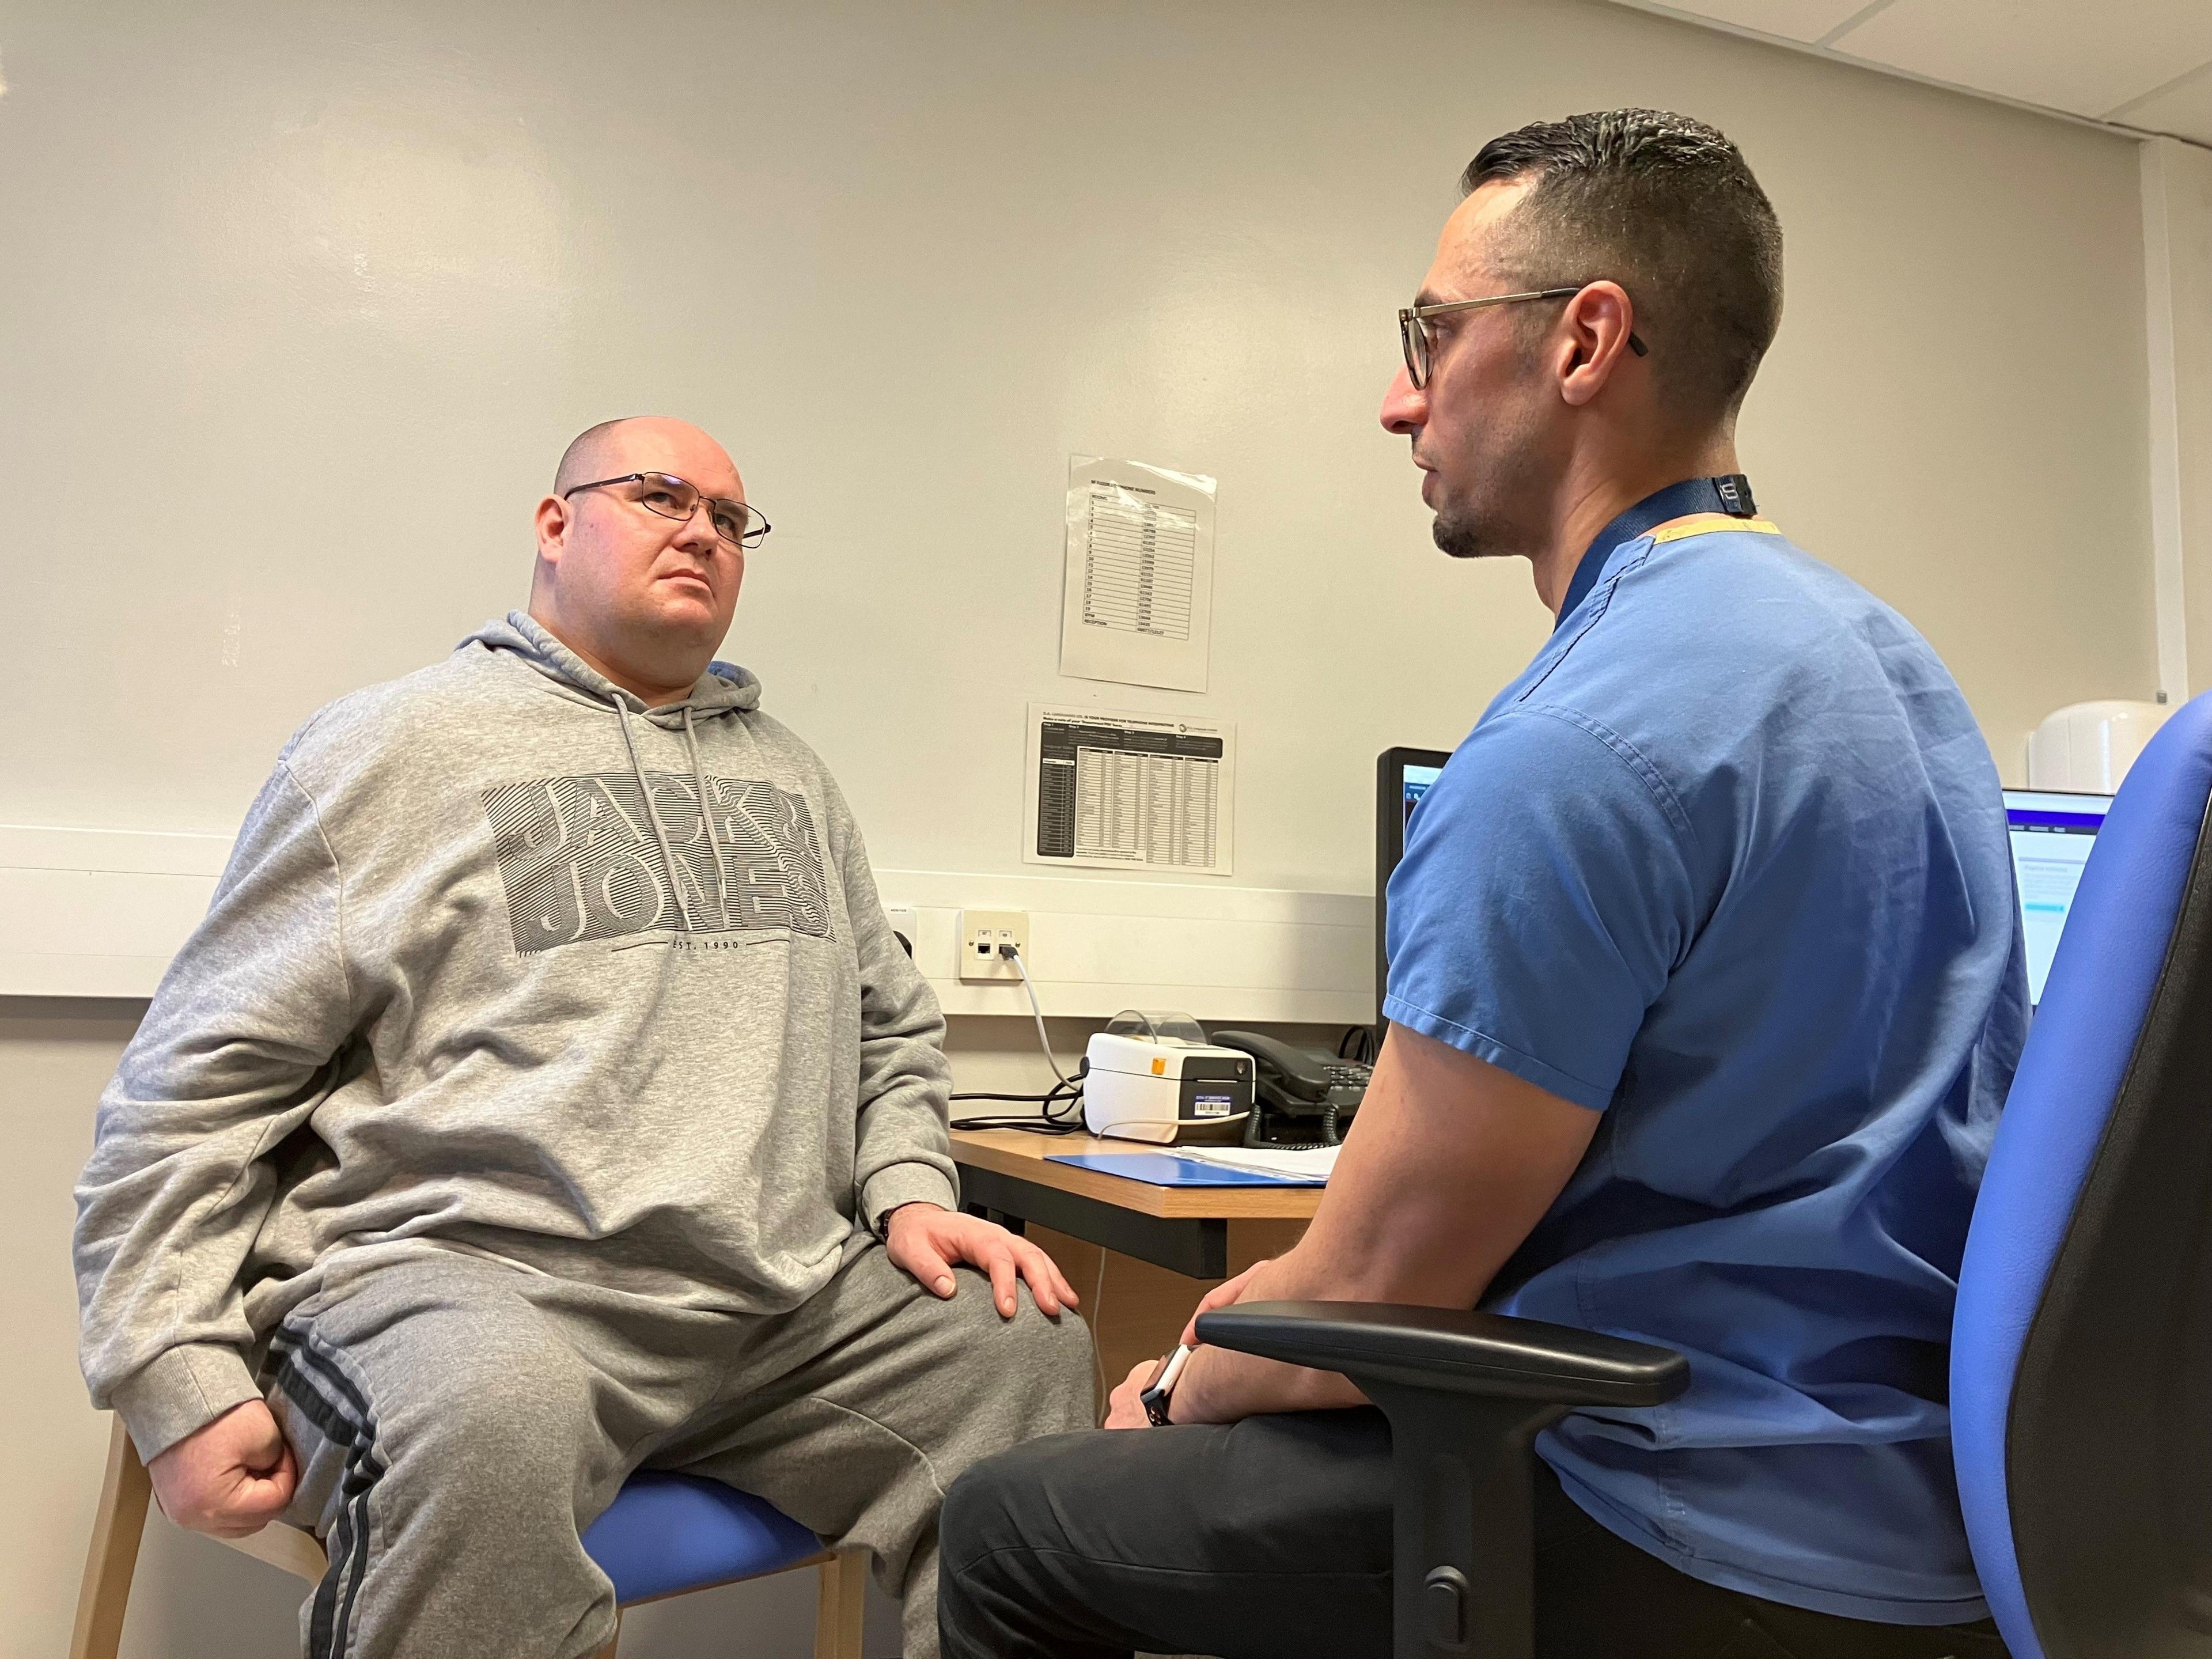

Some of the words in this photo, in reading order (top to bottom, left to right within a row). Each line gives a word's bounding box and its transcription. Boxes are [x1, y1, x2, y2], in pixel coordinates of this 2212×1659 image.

[507, 777, 776, 861] JACK
[525, 853, 831, 941] JONES
[673, 941, 696, 951] EST.
[703, 940, 740, 950] 1990
